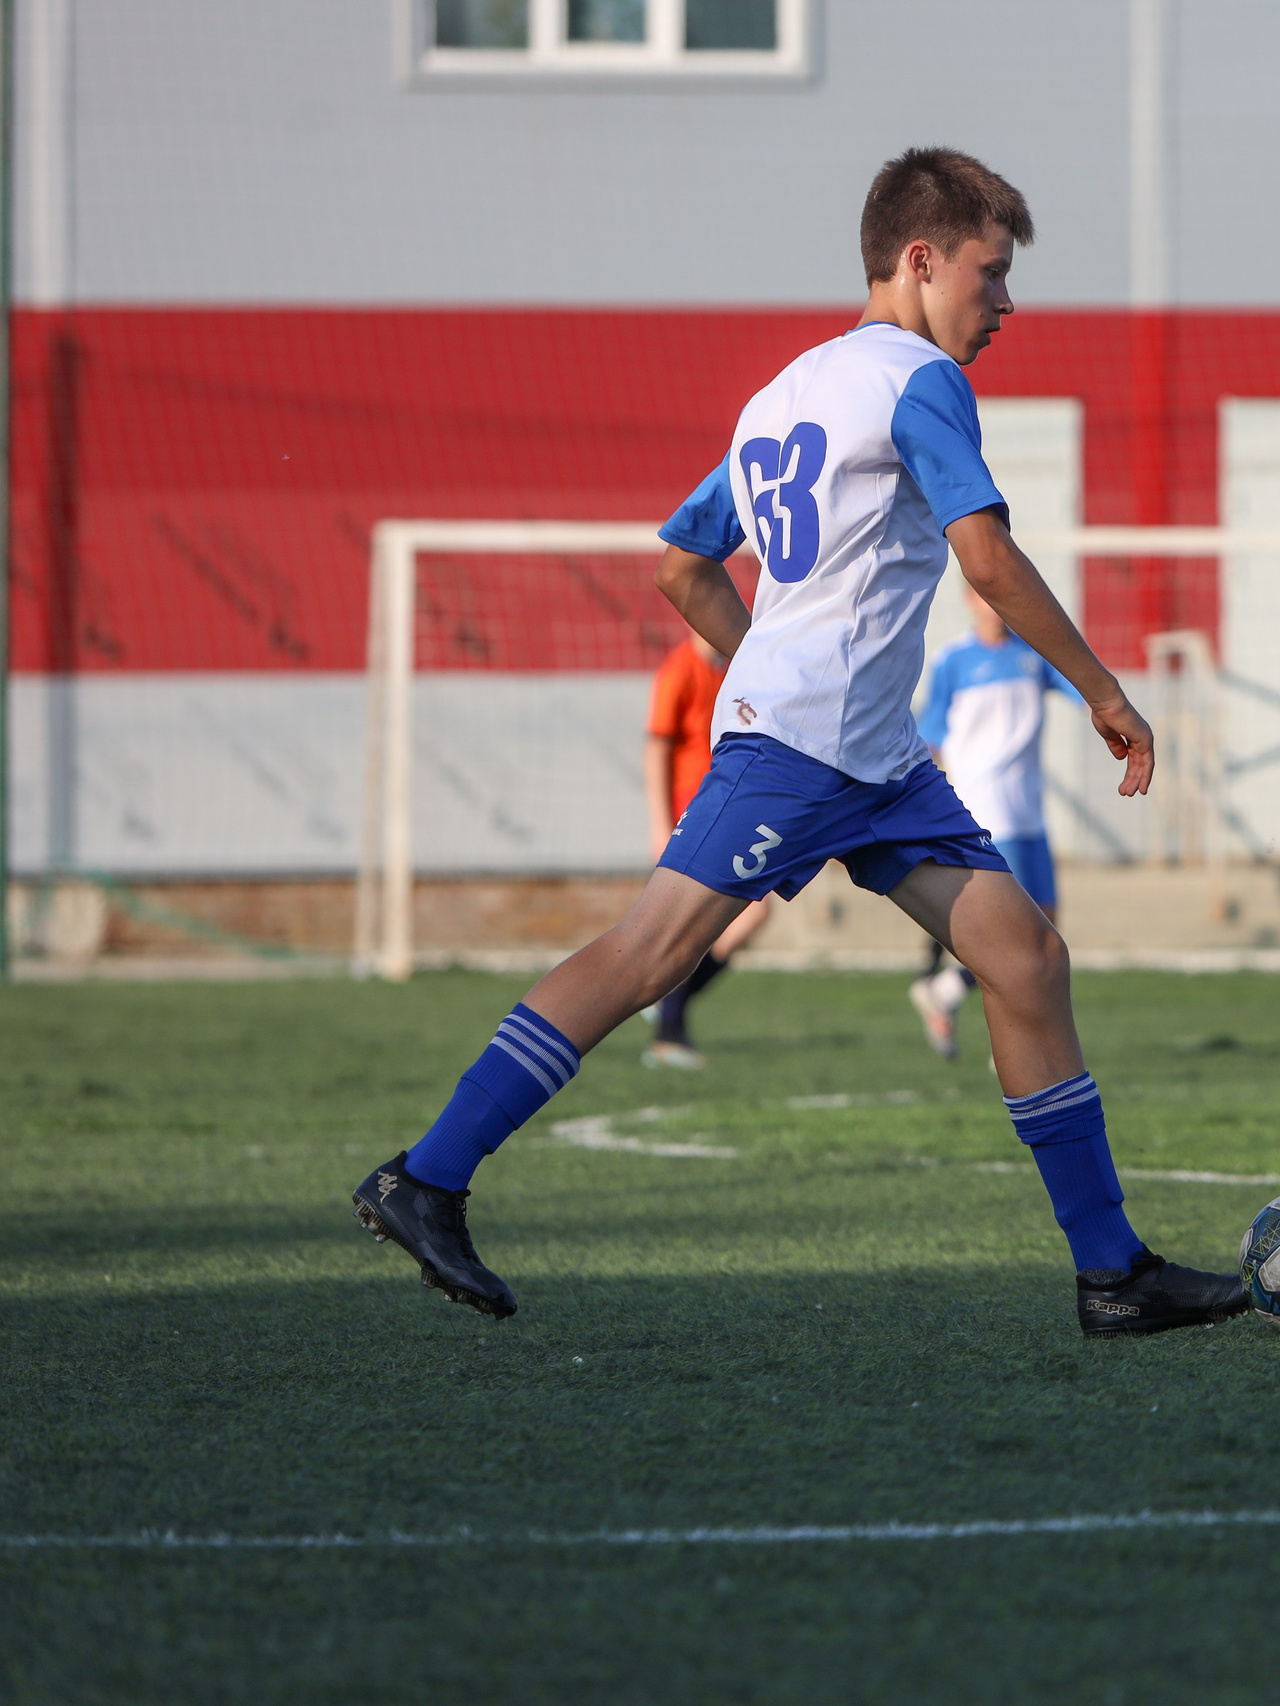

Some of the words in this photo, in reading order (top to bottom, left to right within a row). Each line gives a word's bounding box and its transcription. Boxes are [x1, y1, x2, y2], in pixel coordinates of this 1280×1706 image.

[740, 421, 827, 583] 63
[732, 824, 783, 878] 3
[1087, 1299, 1140, 1317] Kappa
